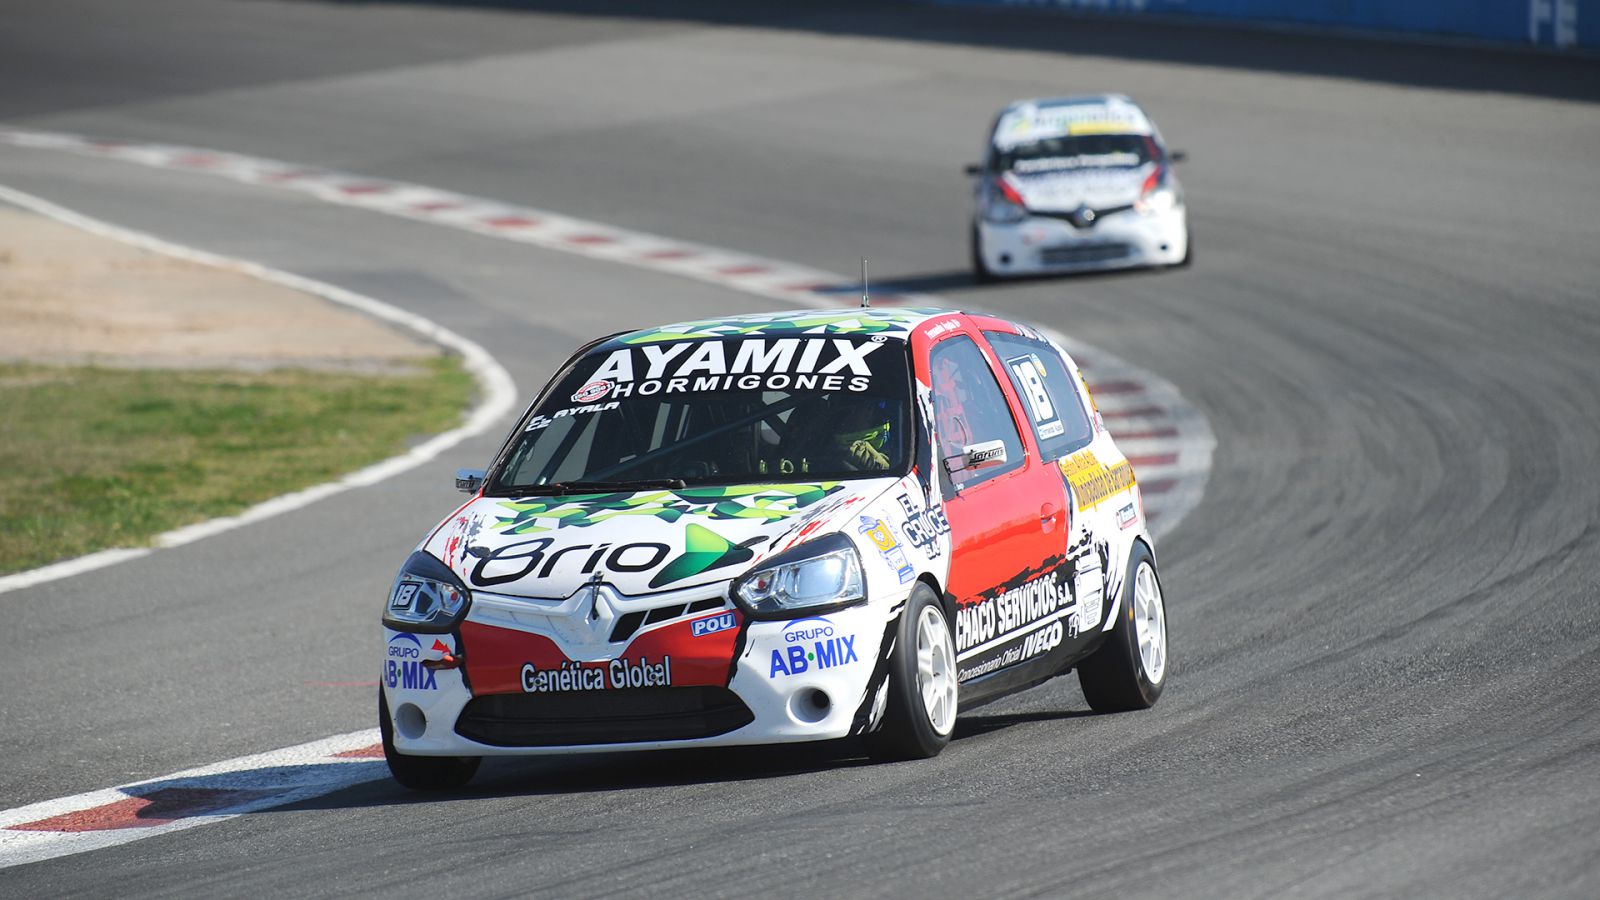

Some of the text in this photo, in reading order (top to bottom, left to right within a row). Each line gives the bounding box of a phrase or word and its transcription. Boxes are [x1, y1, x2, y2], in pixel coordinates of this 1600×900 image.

[583, 338, 885, 388] AYAMIX
[610, 374, 870, 399] HORMIGONES
[1013, 361, 1054, 422] 18
[553, 401, 620, 419] AYALA
[897, 493, 919, 518] EL
[902, 504, 951, 548] CRUCE
[394, 584, 417, 606] 18
[956, 596, 996, 653] CHACO
[998, 571, 1058, 635] SERVICIOS
[694, 615, 733, 635] POU
[785, 626, 834, 643] GRUPO
[388, 646, 419, 659] GRUPO
[1000, 643, 1023, 667] Oficial
[1021, 619, 1063, 661] IVECO
[520, 655, 672, 693] Genética Global
